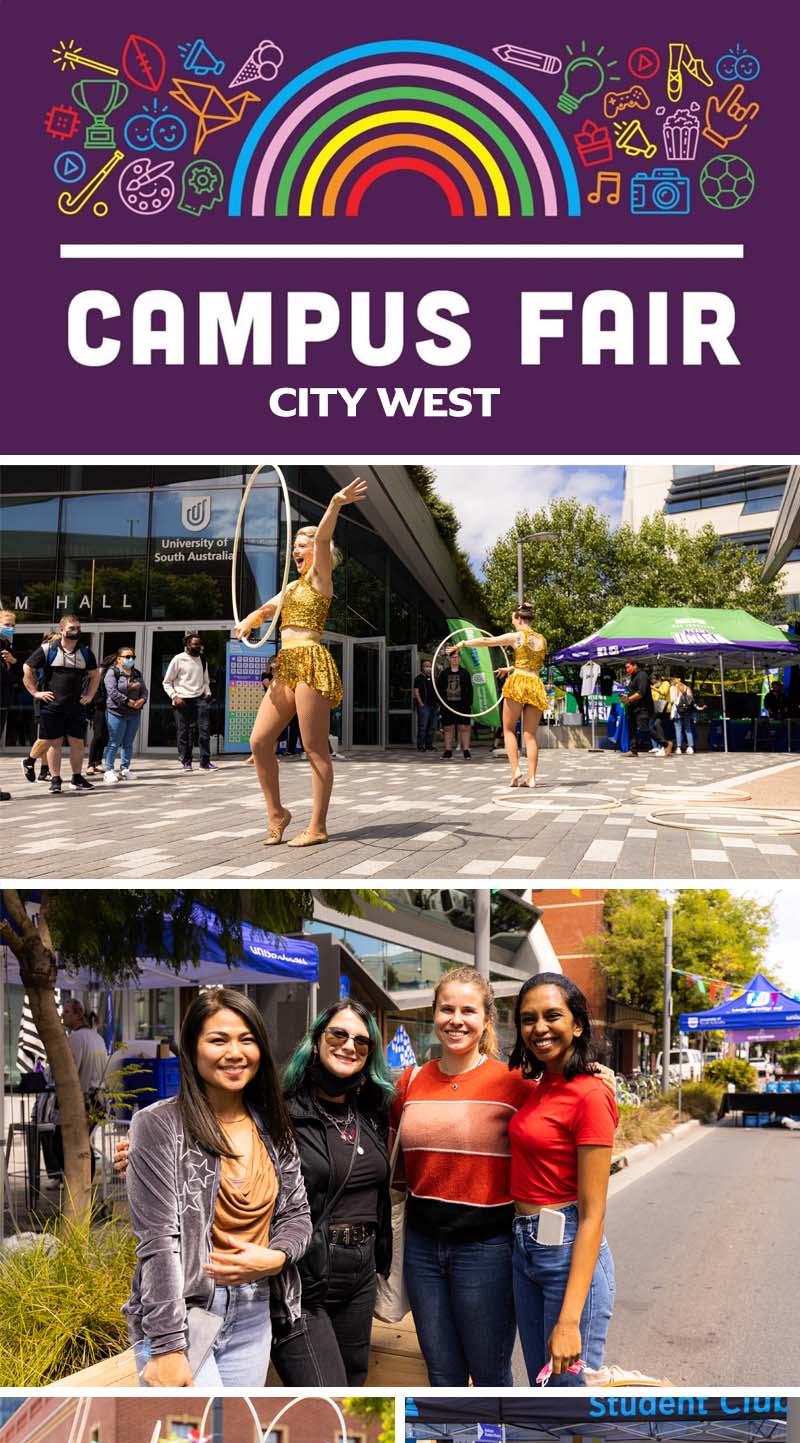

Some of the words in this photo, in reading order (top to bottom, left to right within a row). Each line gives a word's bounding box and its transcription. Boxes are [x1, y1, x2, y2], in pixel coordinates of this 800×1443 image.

[161, 538, 214, 550] University
[216, 537, 228, 547] of
[154, 551, 185, 562] South
[187, 551, 234, 562] Australia
[56, 593, 132, 609] HALL
[588, 1397, 709, 1417] Student
[720, 1397, 787, 1415] Club
